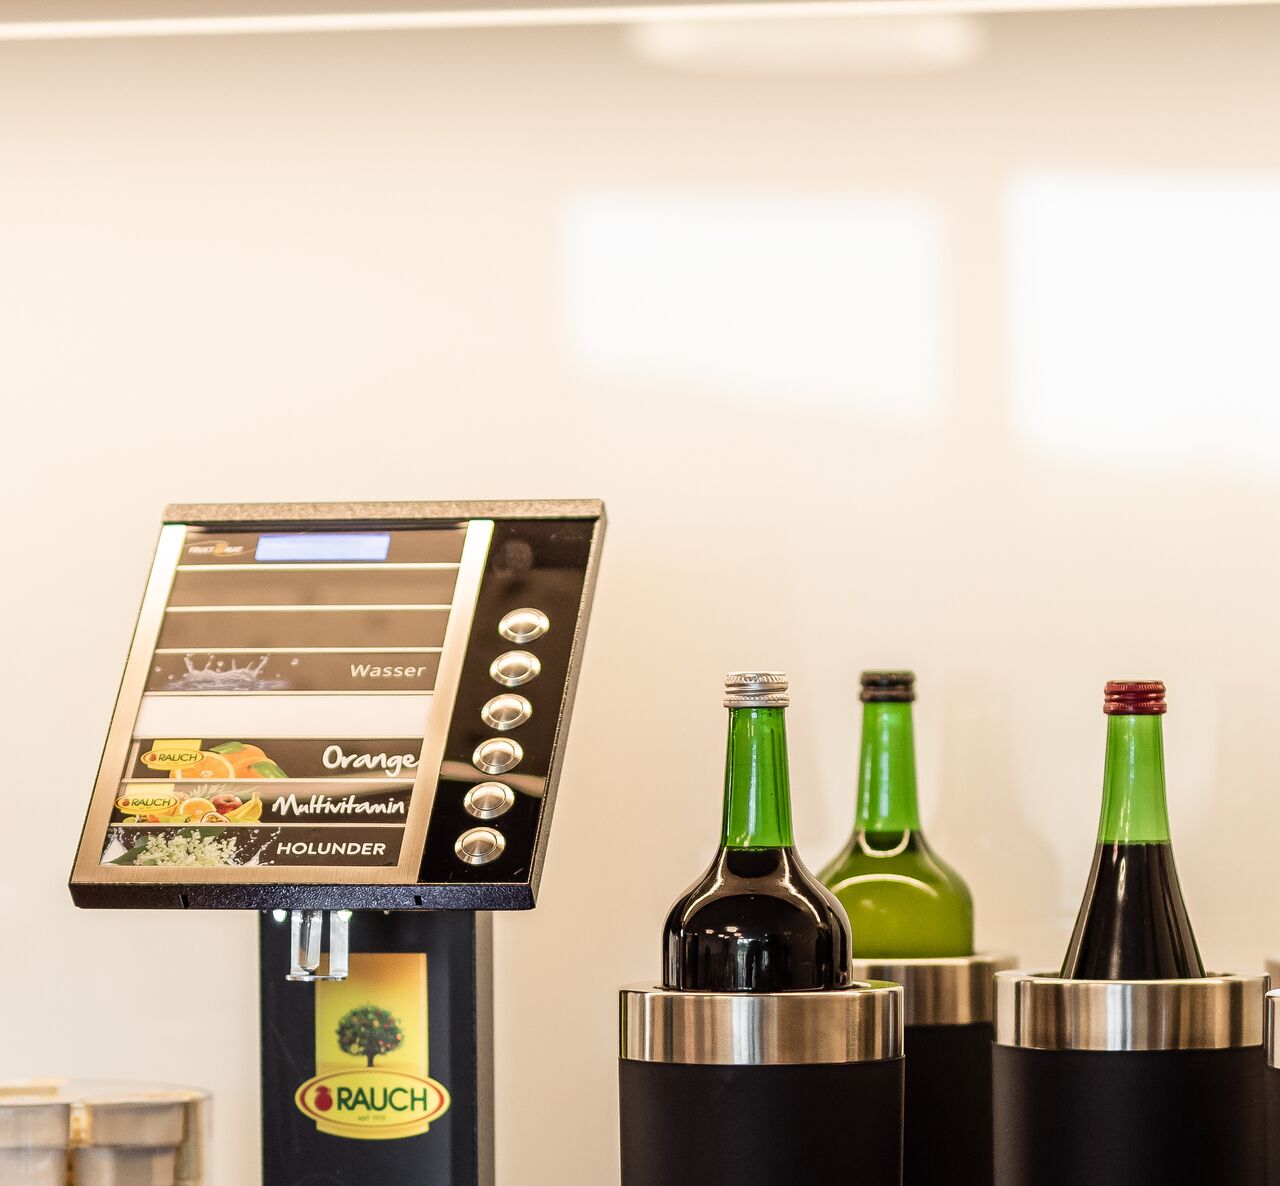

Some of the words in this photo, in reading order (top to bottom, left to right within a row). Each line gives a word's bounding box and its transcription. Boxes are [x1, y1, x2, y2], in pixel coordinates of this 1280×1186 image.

[350, 664, 427, 677] Wasser
[158, 753, 198, 762] RAUCH
[322, 744, 421, 777] Orange
[131, 798, 171, 807] RAUCH
[271, 793, 405, 816] Multivitamin
[276, 842, 386, 856] HOLUNDER
[336, 1087, 428, 1112] RAUCH
